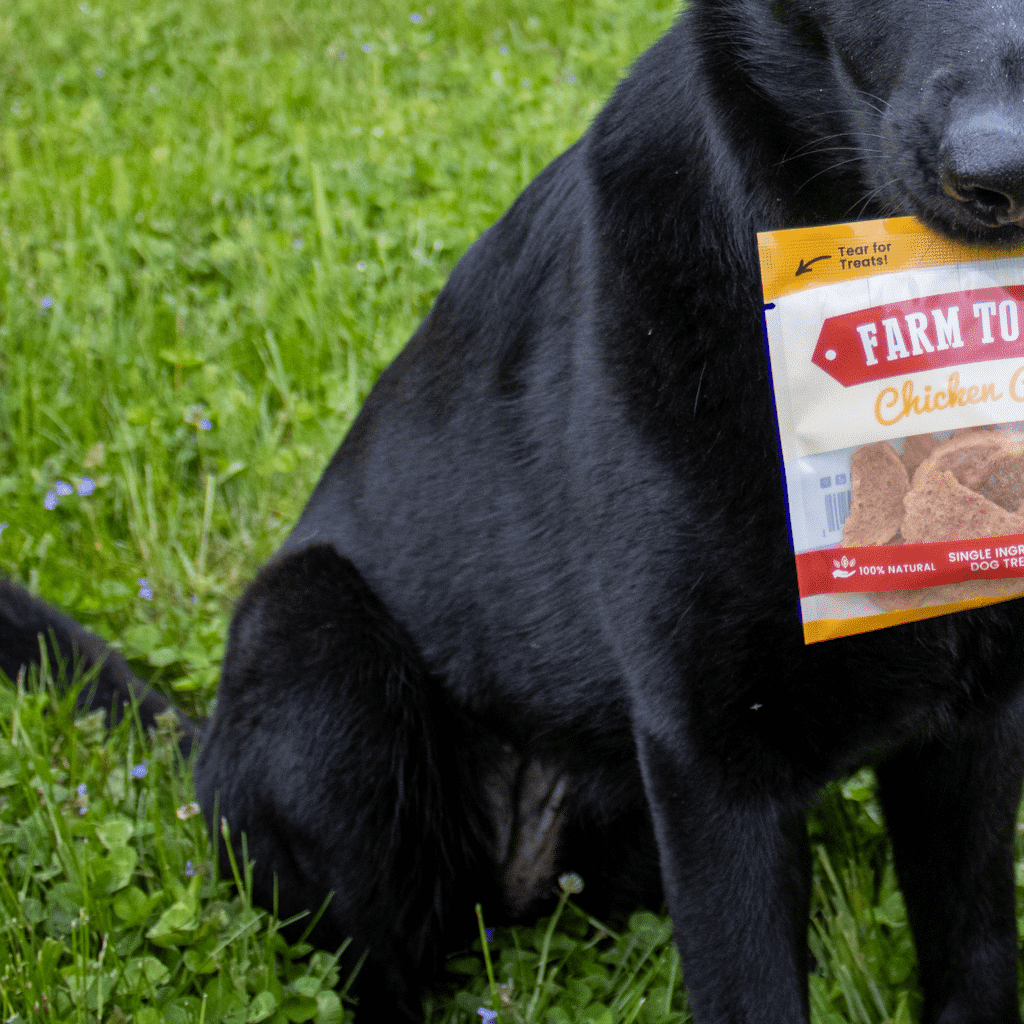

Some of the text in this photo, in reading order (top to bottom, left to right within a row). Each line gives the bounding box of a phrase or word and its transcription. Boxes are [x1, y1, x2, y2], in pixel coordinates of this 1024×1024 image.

[838, 242, 892, 257] Tear for
[839, 254, 888, 270] Treats!
[856, 305, 965, 367] FARM
[972, 299, 1020, 344] TO
[874, 371, 1003, 427] Chicken
[948, 548, 992, 563] SINGLE
[858, 562, 936, 576] 100% NATURAL
[970, 560, 1000, 572] DOG
